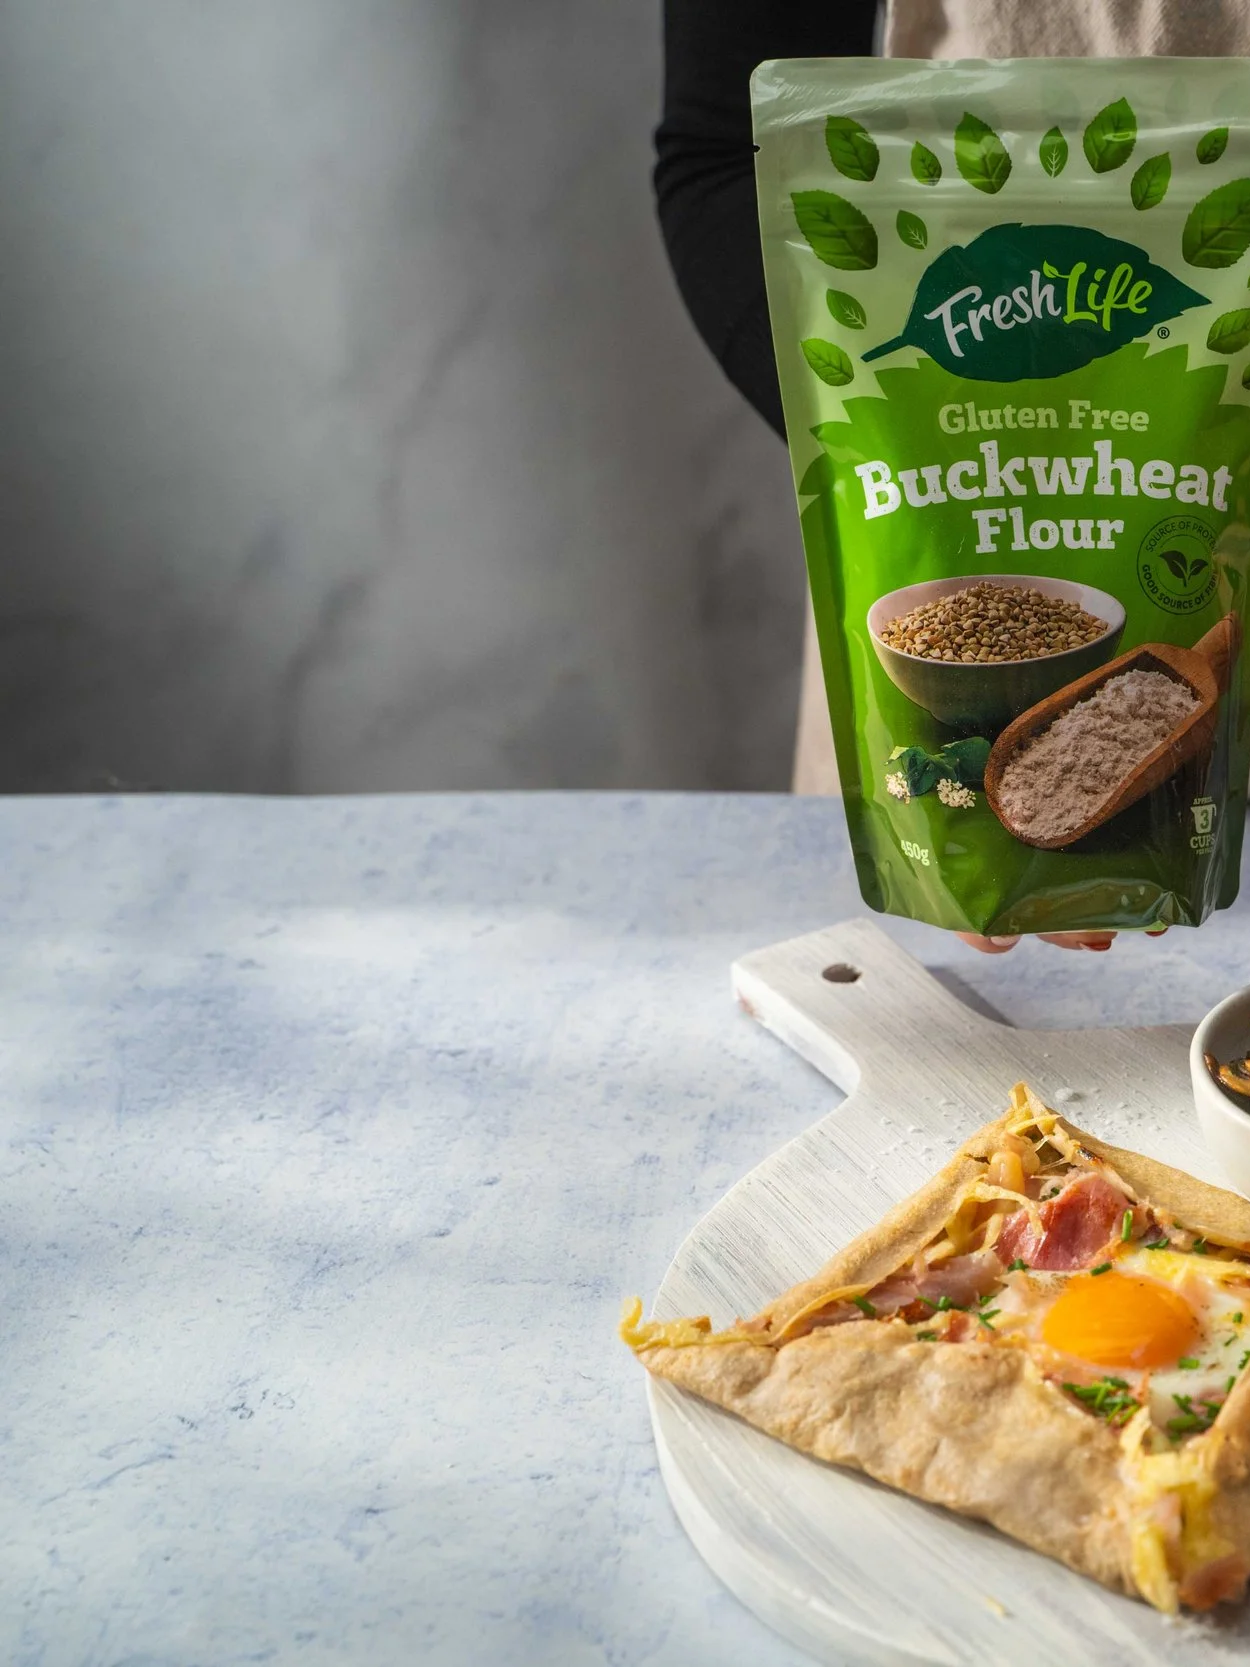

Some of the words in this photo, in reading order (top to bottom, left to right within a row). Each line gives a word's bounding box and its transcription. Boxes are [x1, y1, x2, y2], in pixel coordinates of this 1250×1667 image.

[938, 401, 1059, 435] Gluten
[1068, 399, 1150, 432] Free
[854, 439, 1233, 520] Buckwheat
[972, 506, 1125, 554] Flour
[1145, 522, 1177, 553] SOURCE
[1178, 520, 1192, 531] OF
[1142, 563, 1160, 595] GOOD
[1157, 592, 1194, 610] SOURCE
[1194, 594, 1206, 605] OF
[1200, 808, 1210, 830] 3
